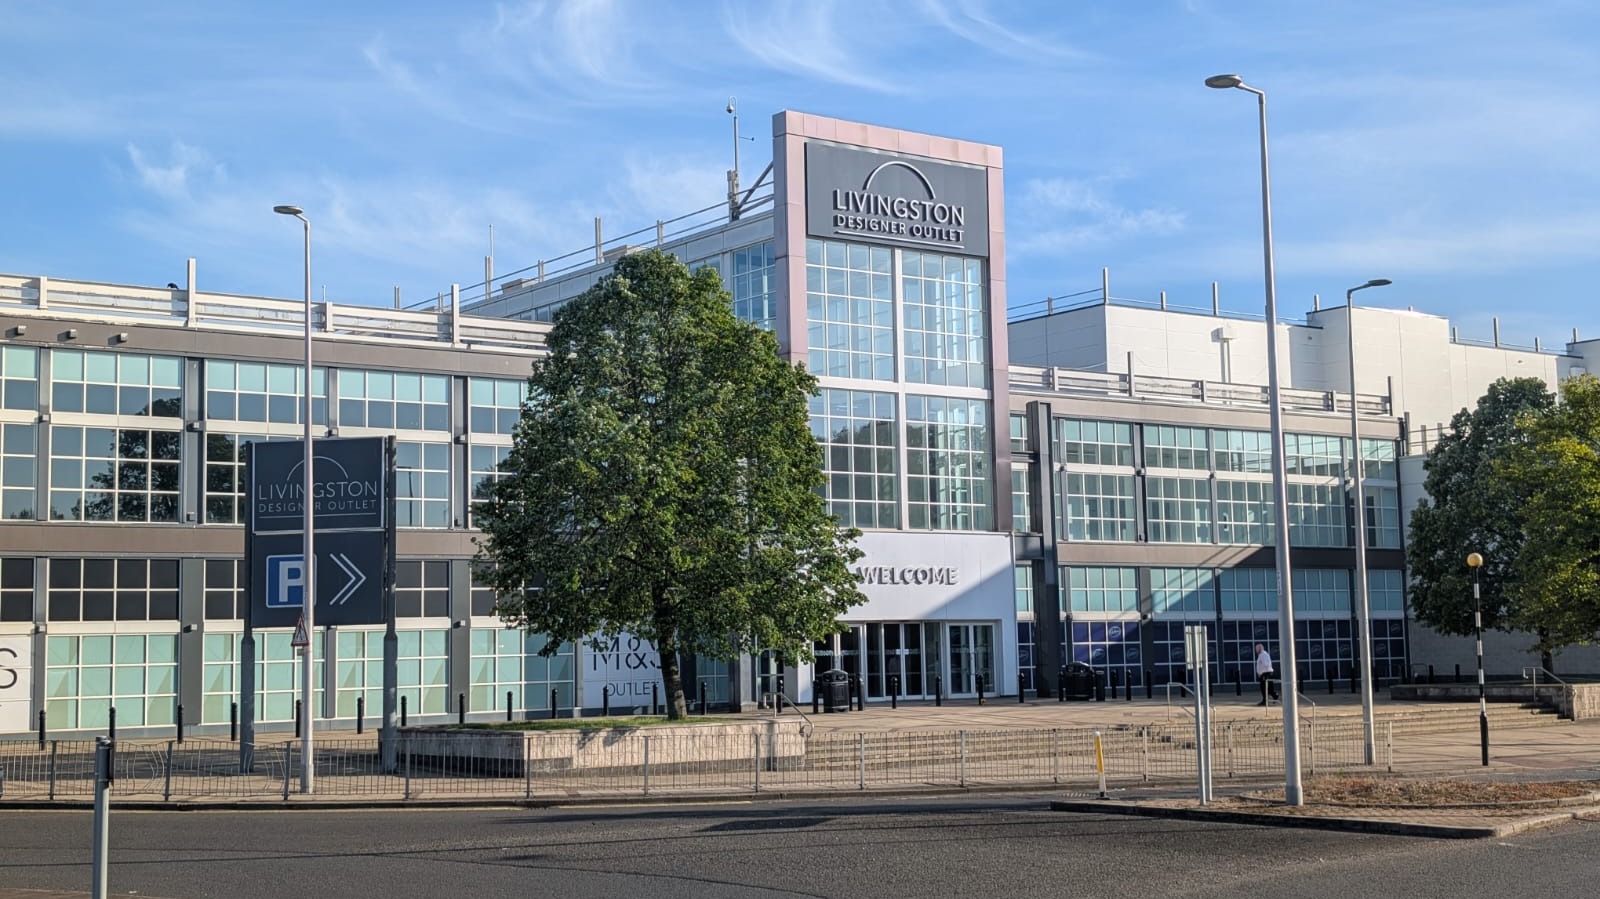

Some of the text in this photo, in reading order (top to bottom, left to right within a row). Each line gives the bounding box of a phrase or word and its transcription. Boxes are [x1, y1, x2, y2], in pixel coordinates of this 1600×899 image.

[834, 189, 965, 226] LIVINGSTON
[835, 214, 965, 242] DESIGNER OUTLET
[258, 480, 377, 500] LIVINGSTON
[258, 499, 377, 513] DESIGNR OUTLET
[278, 560, 305, 603] P
[856, 565, 960, 586] WELCOME
